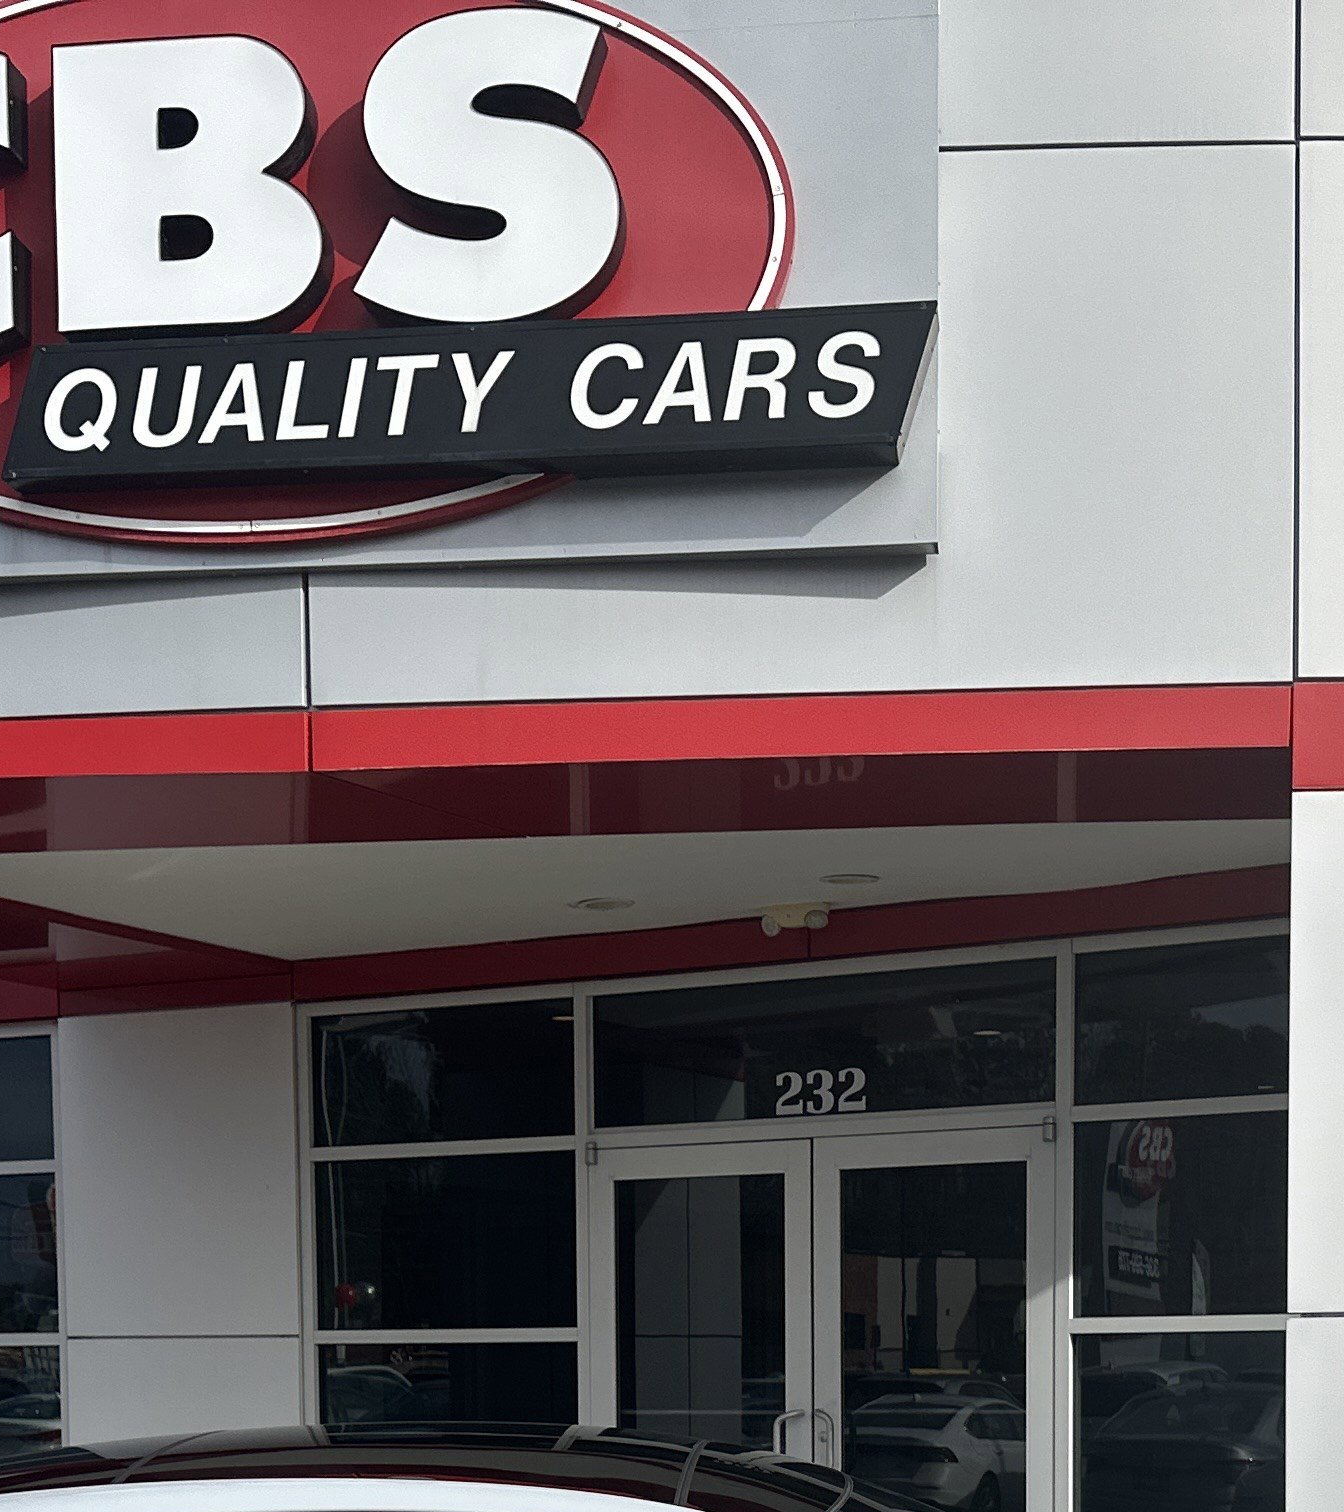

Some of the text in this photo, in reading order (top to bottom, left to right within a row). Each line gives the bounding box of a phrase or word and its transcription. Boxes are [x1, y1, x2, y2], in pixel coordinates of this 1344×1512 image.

[41, 329, 881, 454] QUALITY CARS
[775, 1067, 867, 1116] 232
